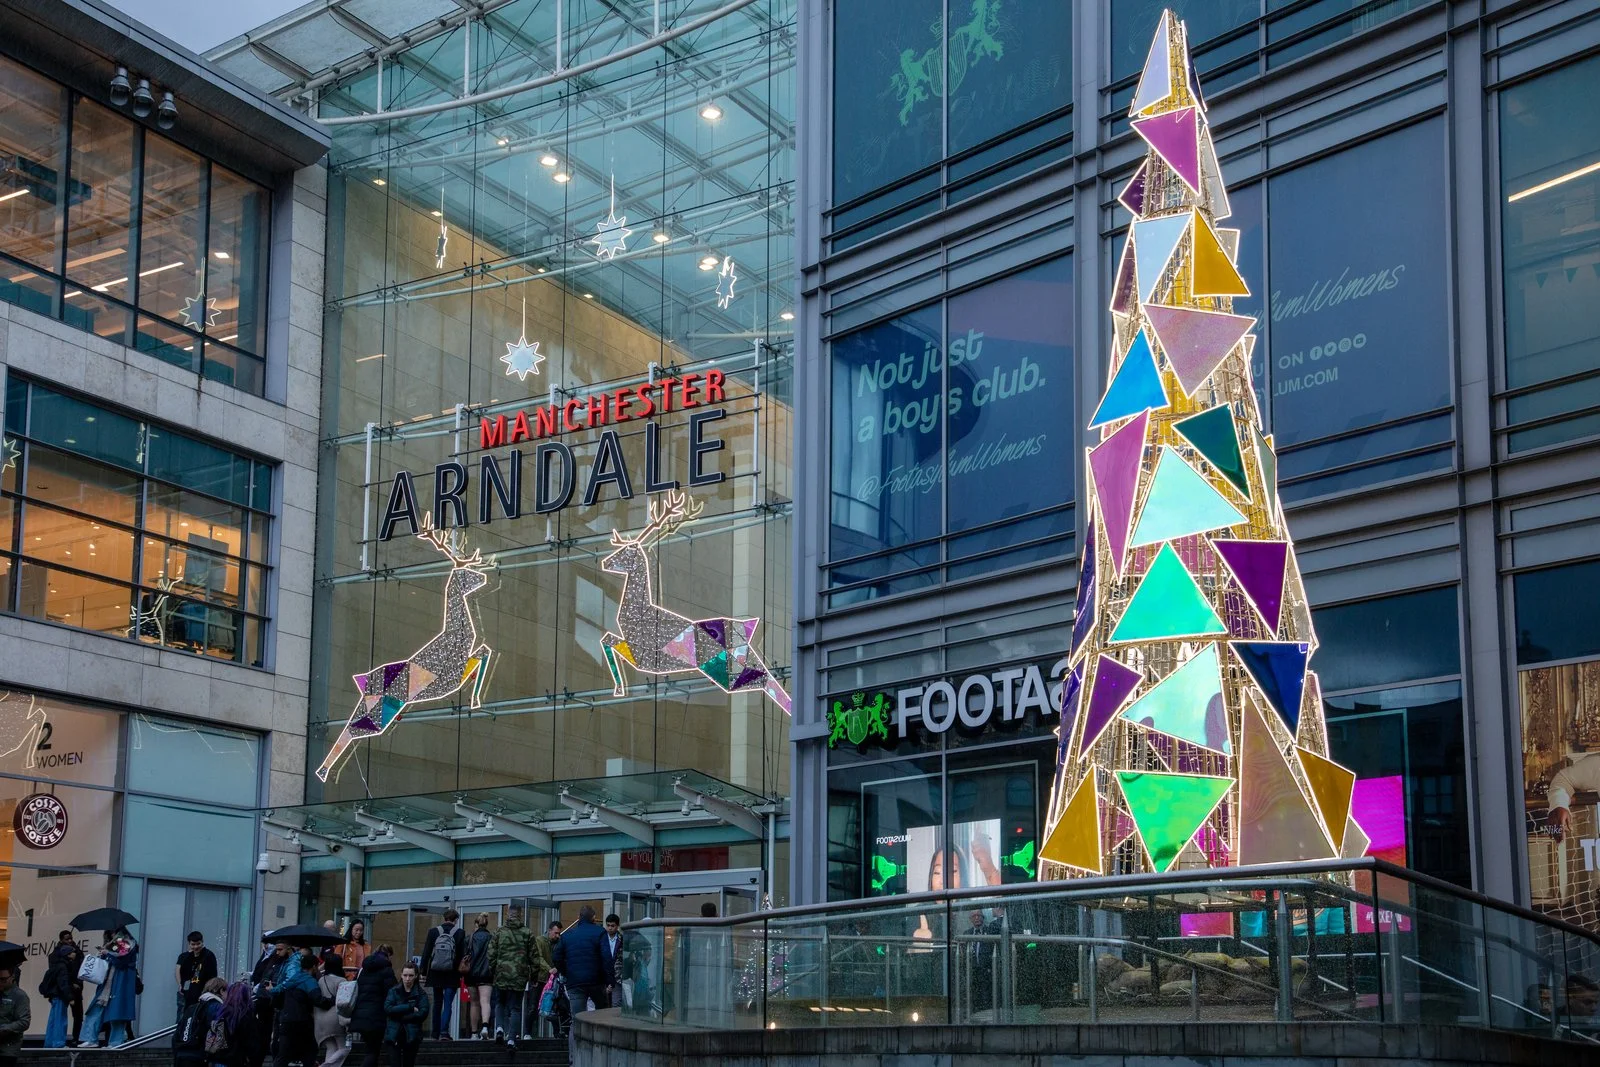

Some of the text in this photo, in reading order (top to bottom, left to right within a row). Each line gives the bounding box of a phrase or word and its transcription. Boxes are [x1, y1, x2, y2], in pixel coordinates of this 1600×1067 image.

[857, 328, 984, 398] Not just
[1278, 351, 1304, 369] ON
[480, 369, 726, 449] MANCHESTER
[857, 356, 1046, 443] a boys club.
[379, 408, 726, 541] ARNDALE
[37, 722, 53, 751] 2
[37, 751, 83, 769] WOMEN
[29, 799, 60, 815] COSTA
[25, 824, 62, 844] COFFEE
[1543, 824, 1563, 834] Nike
[25, 908, 34, 937] 1
[24, 939, 89, 957] MEN/ME
[83, 955, 97, 979] M&S
